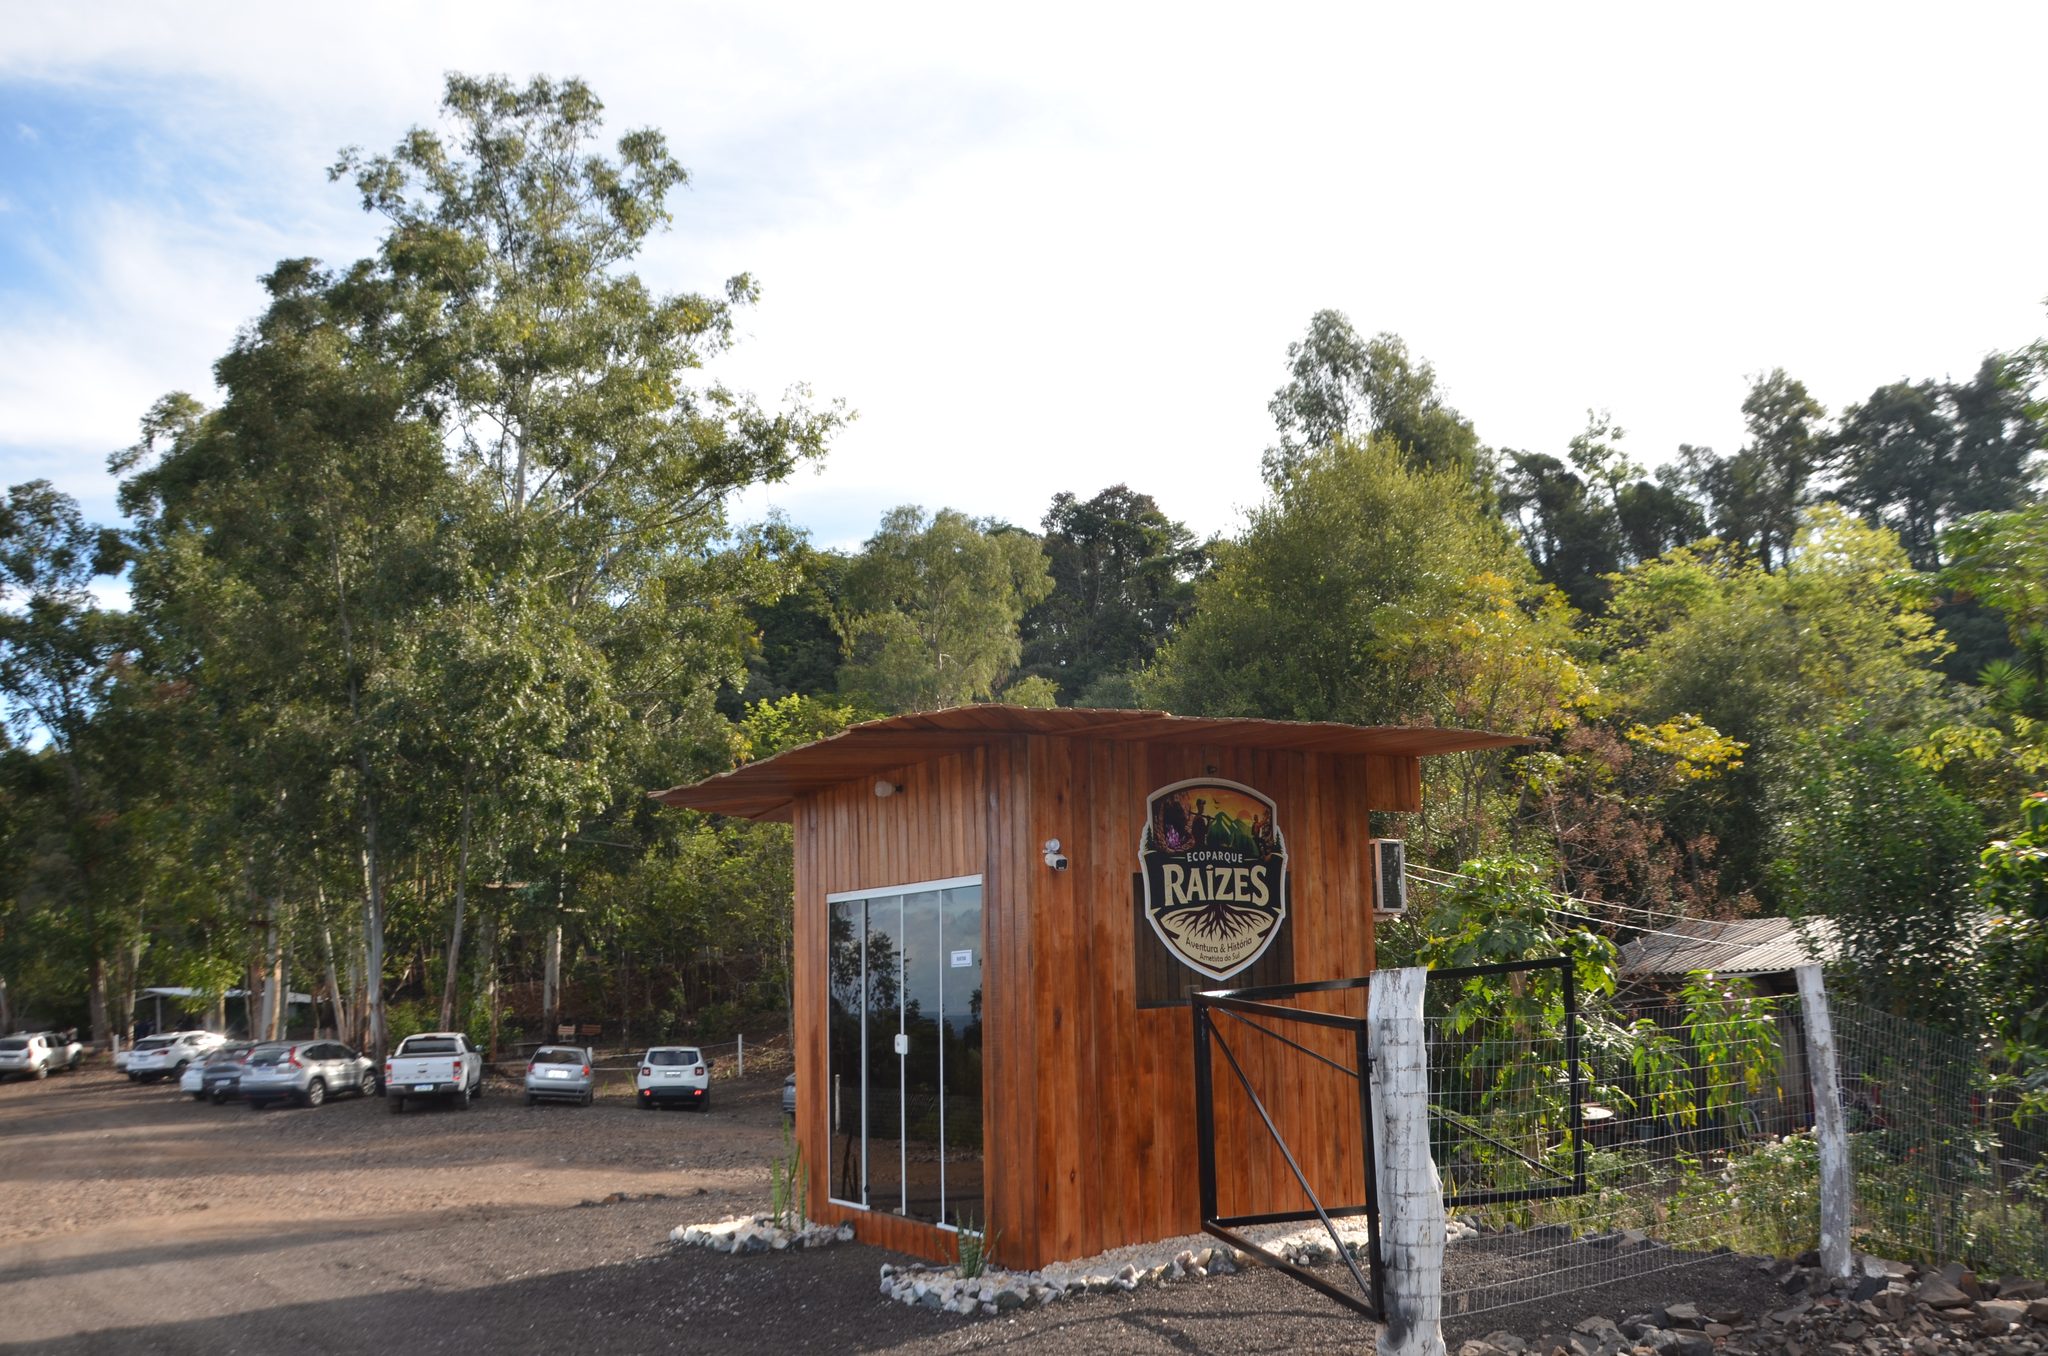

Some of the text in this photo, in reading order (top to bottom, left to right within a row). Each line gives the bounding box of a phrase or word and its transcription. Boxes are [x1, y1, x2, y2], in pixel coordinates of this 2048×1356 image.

[1186, 851, 1243, 863] ECOPARQUE
[1186, 937, 1218, 953] Aventura
[1220, 944, 1226, 953] &
